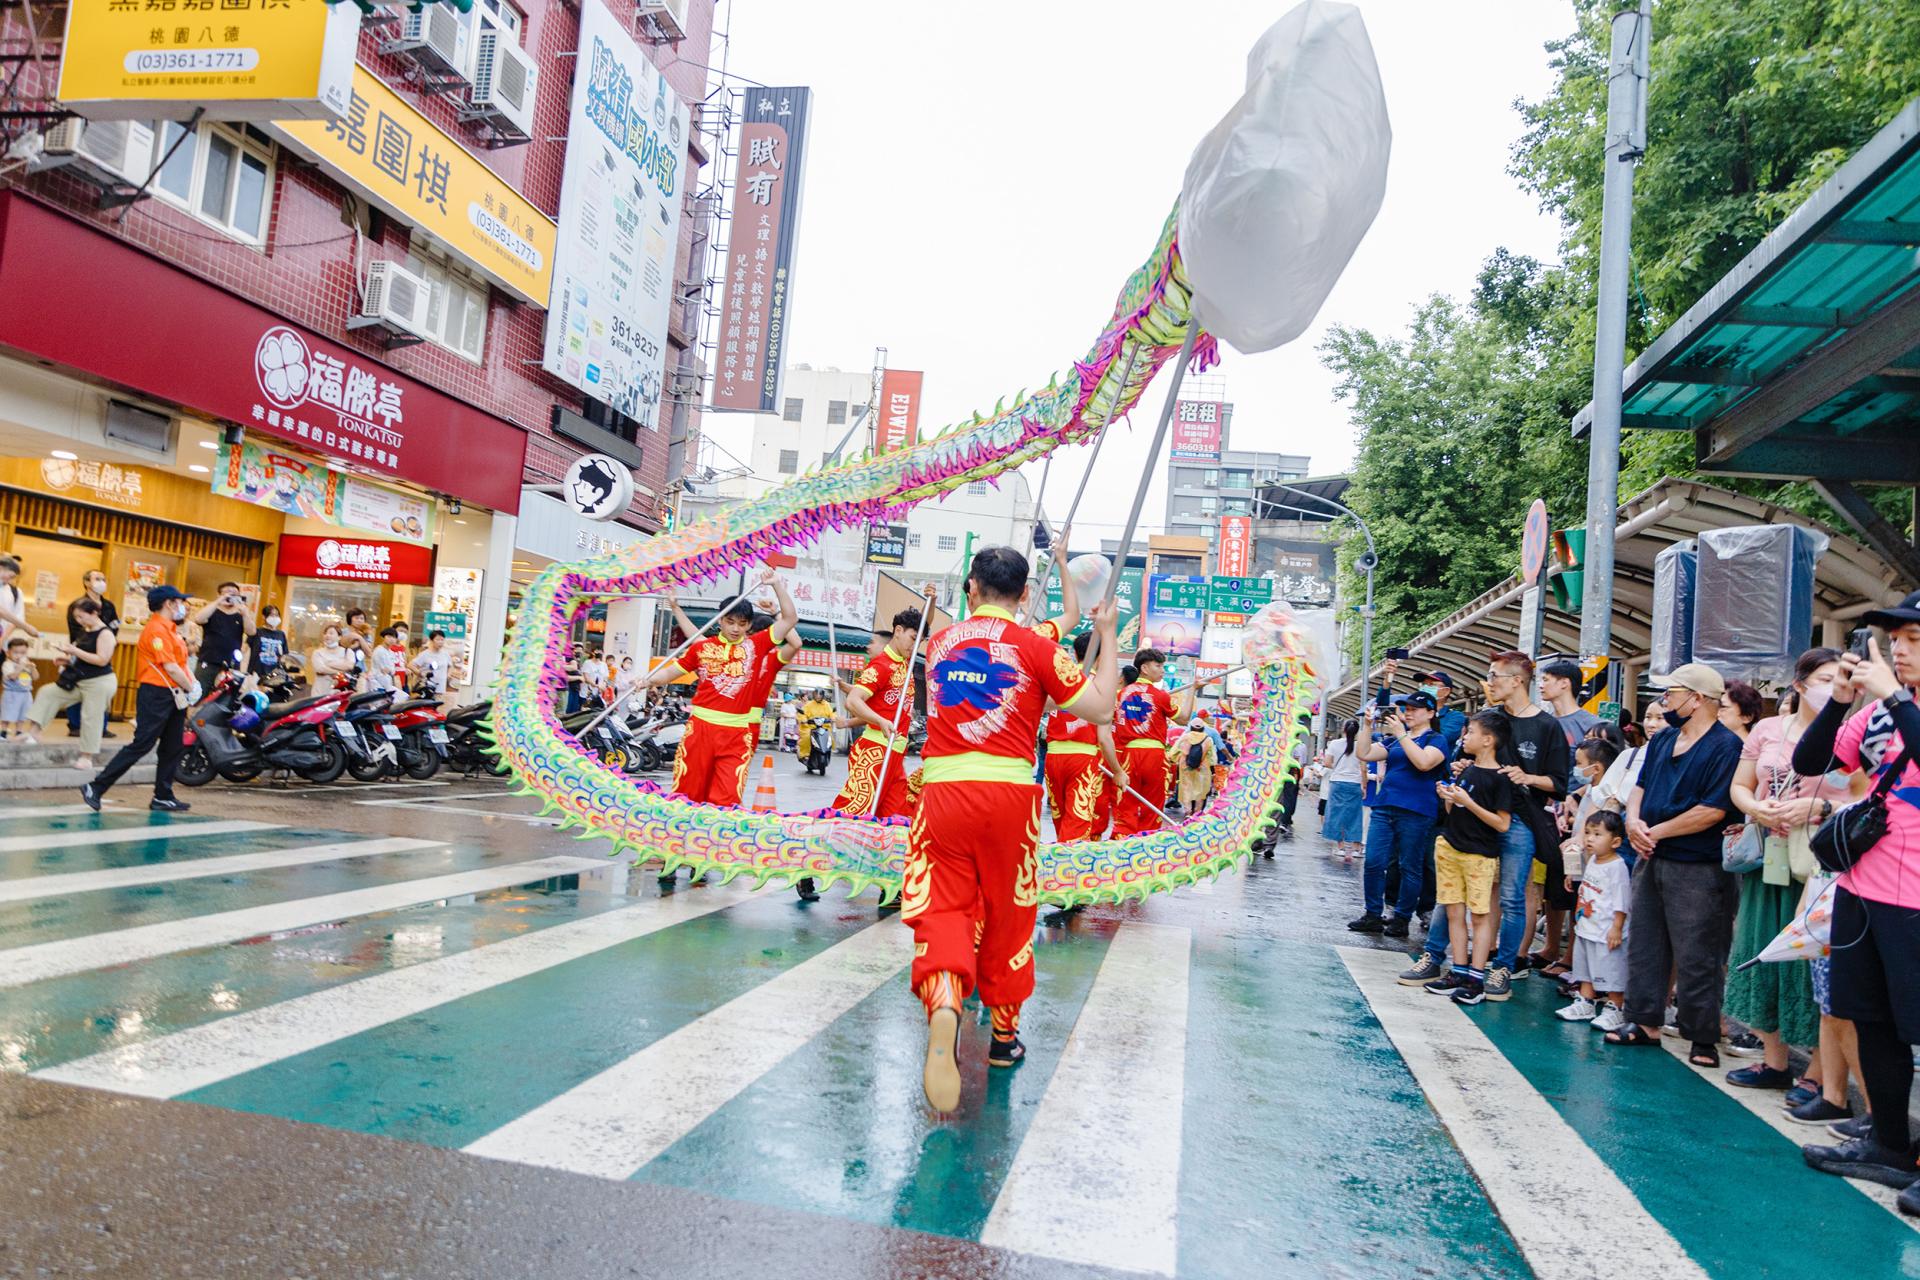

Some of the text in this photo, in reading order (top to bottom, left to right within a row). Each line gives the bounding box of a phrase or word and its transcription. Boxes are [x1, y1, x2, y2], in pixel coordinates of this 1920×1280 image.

[137, 52, 244, 71] (03)361-1771
[758, 97, 792, 116] 私立
[627, 107, 677, 196] 國小部
[744, 136, 782, 206] 賦有
[477, 209, 537, 265] (03)361-1771
[611, 315, 659, 361] 361-8237
[308, 351, 404, 428] 福勝亭
[1179, 401, 1217, 423] 招租
[336, 413, 402, 449] TONKATSU
[887, 393, 910, 446] EDWIN
[947, 670, 987, 685] NTSU
